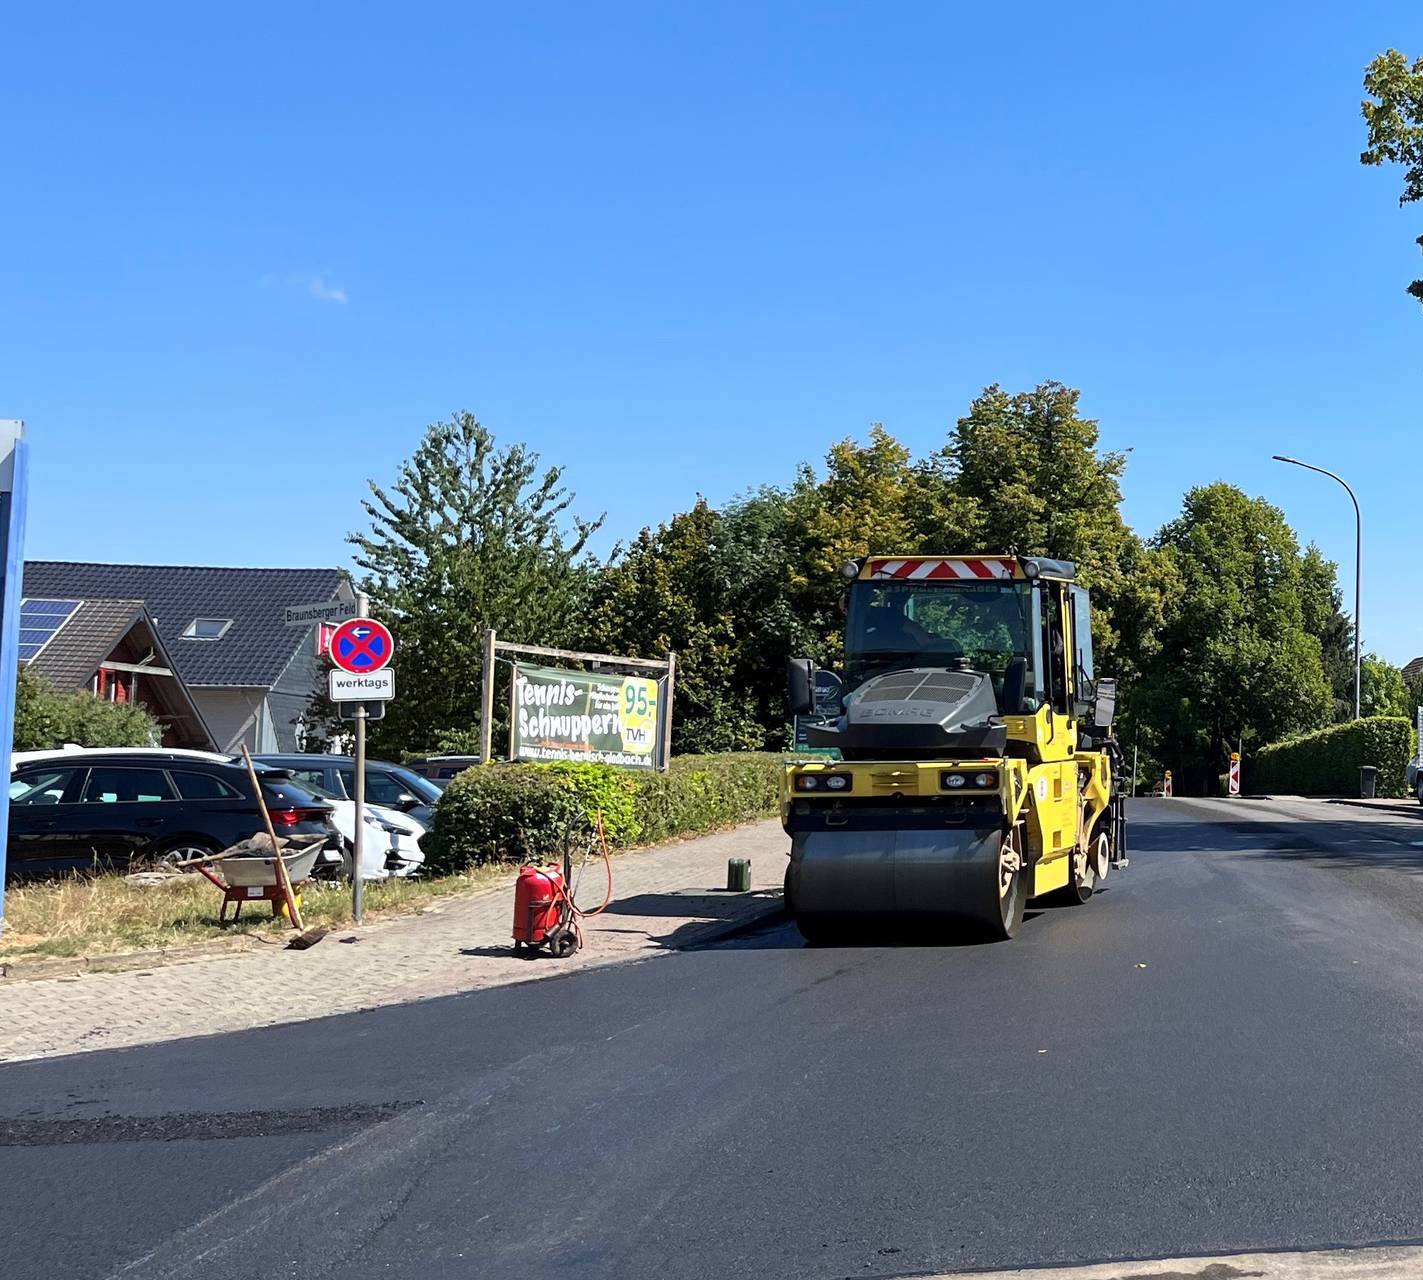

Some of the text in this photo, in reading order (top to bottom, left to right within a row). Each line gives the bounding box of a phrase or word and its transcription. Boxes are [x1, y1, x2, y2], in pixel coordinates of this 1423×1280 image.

[286, 603, 356, 622] Braunsberger Feld
[336, 679, 389, 690] werktags
[516, 676, 583, 706] Tennis-
[627, 728, 646, 742] TVH
